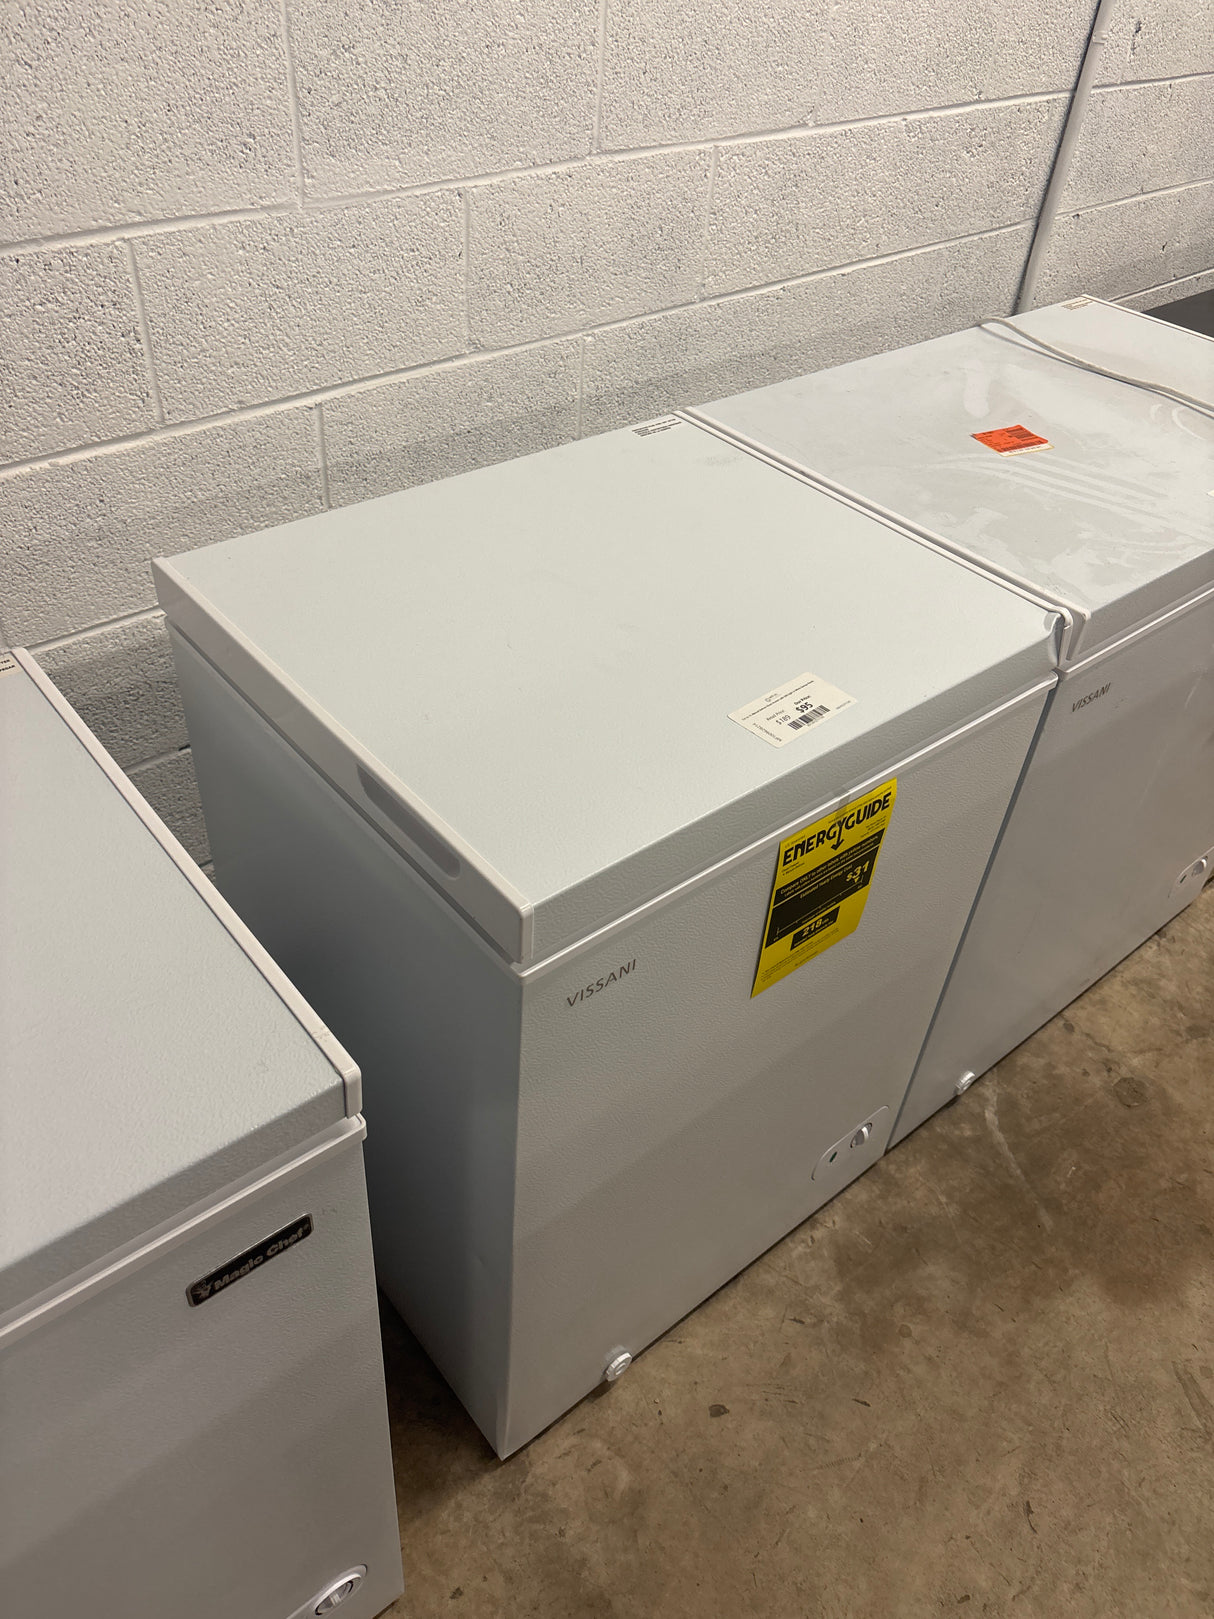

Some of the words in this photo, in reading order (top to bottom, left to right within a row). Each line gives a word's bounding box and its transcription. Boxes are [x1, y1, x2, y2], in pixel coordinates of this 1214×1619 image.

[795, 702, 813, 713] $95
[1072, 682, 1111, 712] VISSANI
[782, 791, 892, 868] ENERGYGUIDE
[846, 860, 870, 882] $31
[566, 959, 636, 1007] VISSANI
[266, 1227, 304, 1256] Chef
